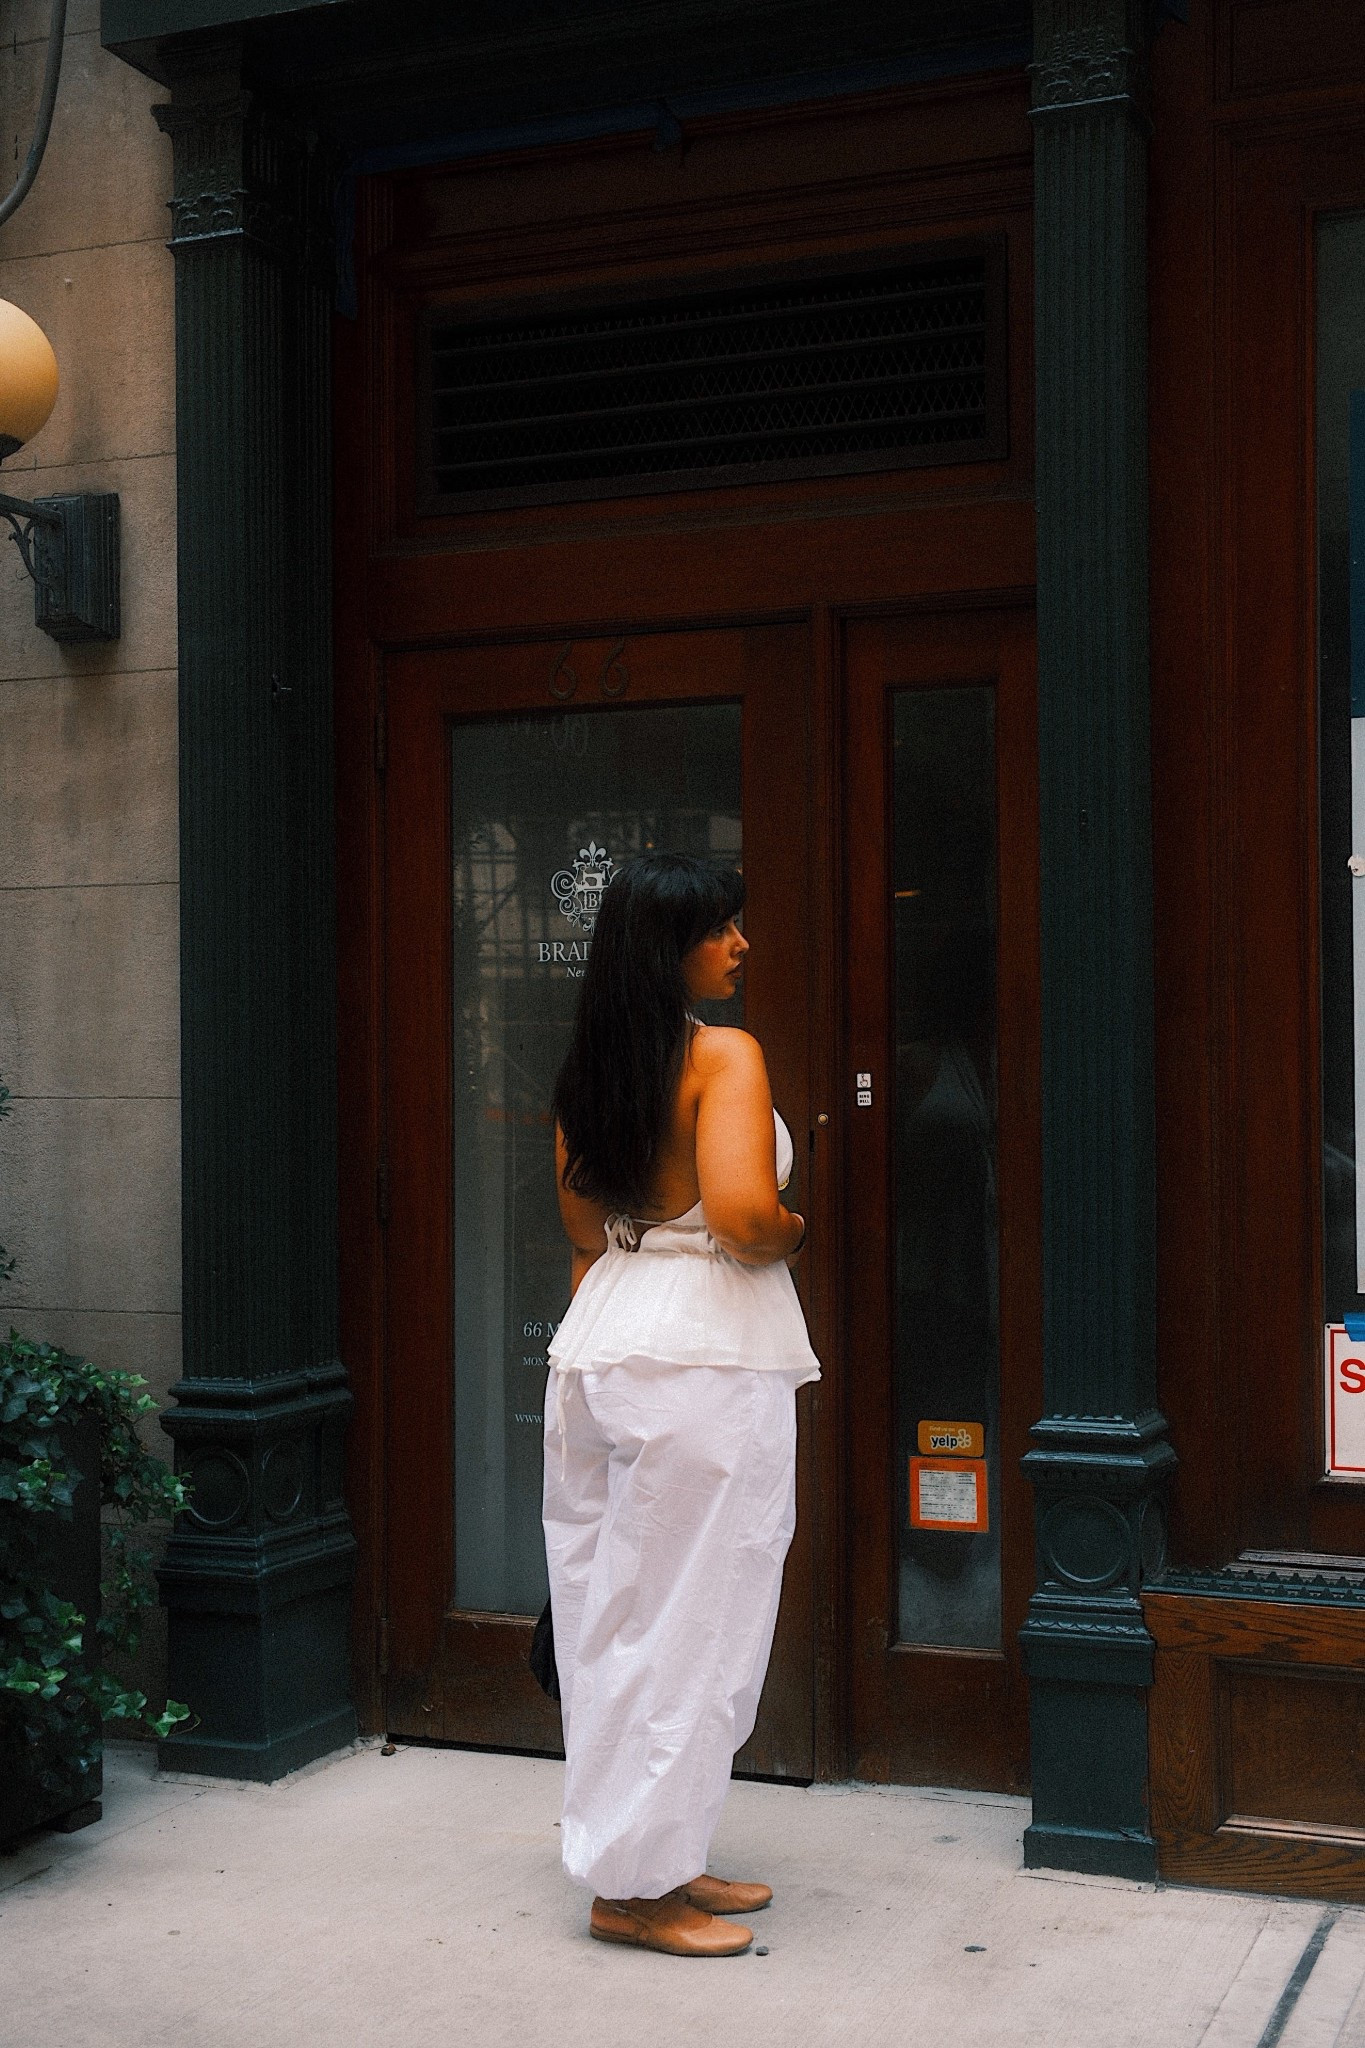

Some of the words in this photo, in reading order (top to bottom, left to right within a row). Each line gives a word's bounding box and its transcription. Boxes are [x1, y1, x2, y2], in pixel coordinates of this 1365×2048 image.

[549, 637, 629, 700] 66
[523, 1321, 543, 1338] 66
[523, 1357, 545, 1366] MON
[930, 1434, 958, 1450] yelp
